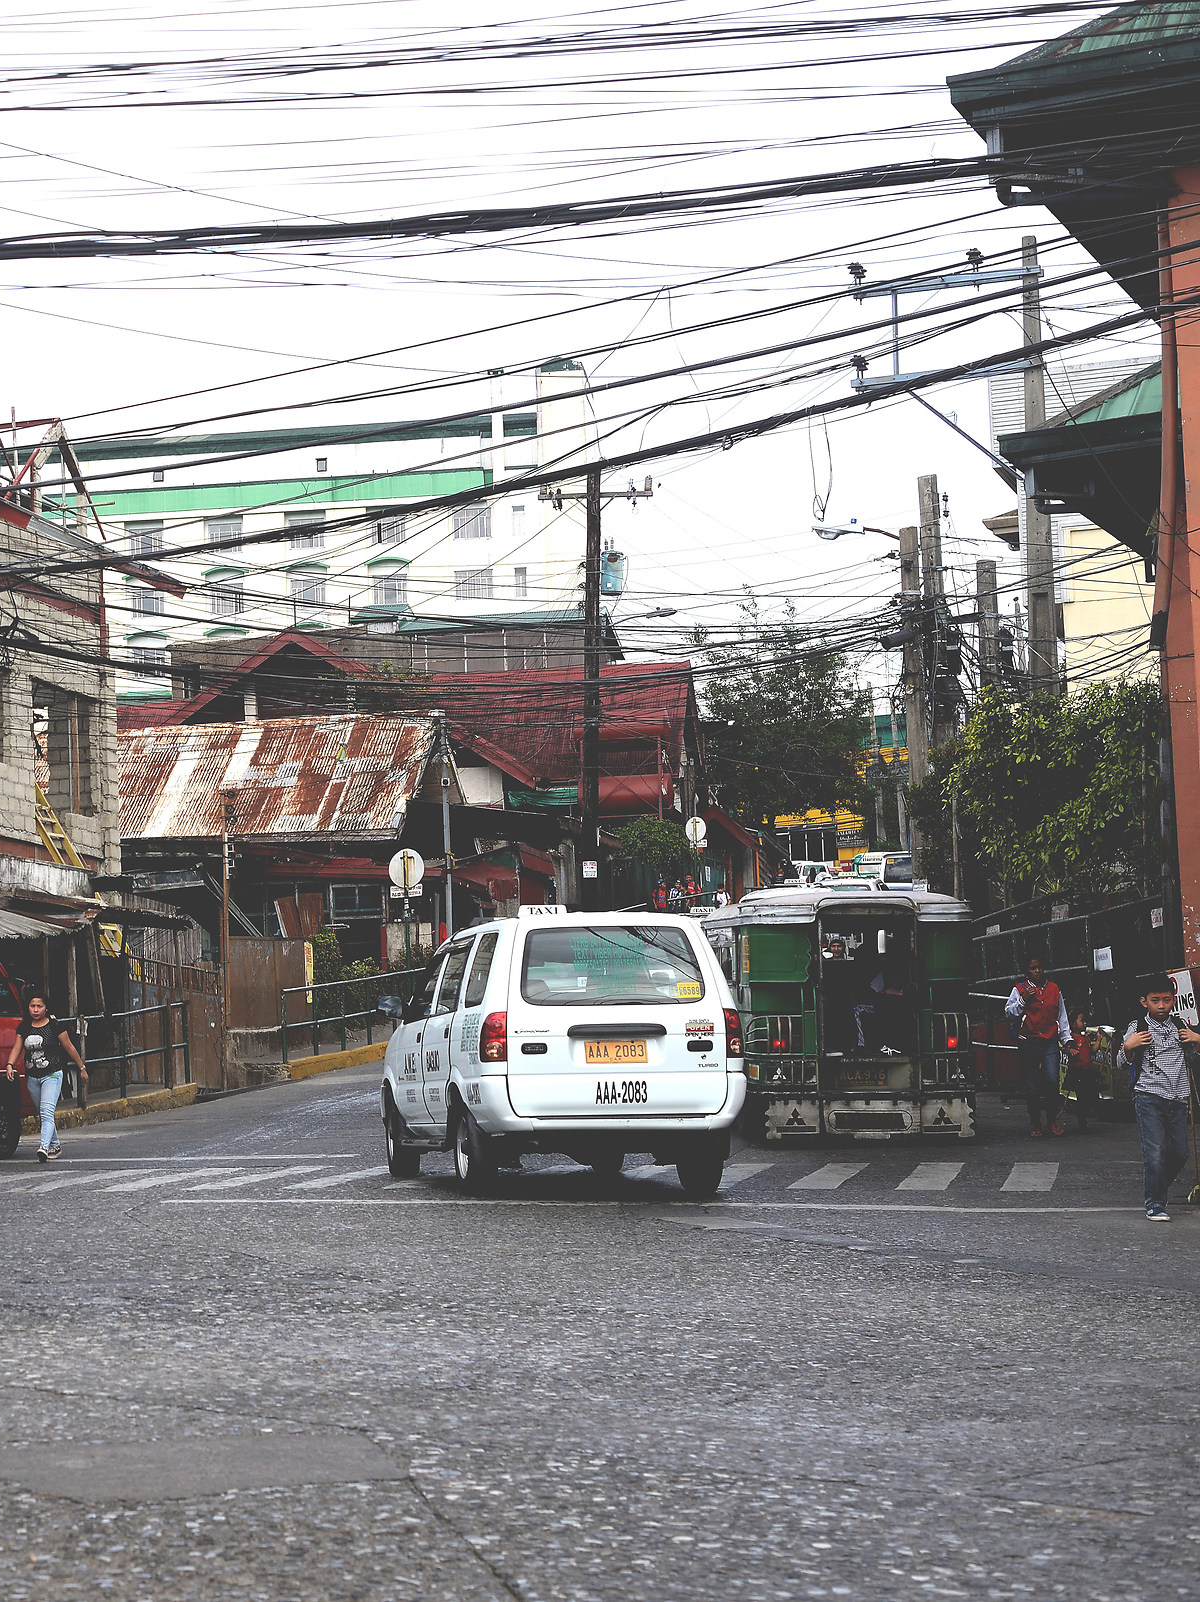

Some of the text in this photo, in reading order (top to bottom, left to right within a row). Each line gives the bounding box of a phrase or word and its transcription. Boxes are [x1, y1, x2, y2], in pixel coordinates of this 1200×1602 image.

[527, 906, 558, 915] TAXI
[682, 985, 700, 996] 6589
[588, 1044, 645, 1058] AAA 2083
[595, 1080, 648, 1105] AAA-2083
